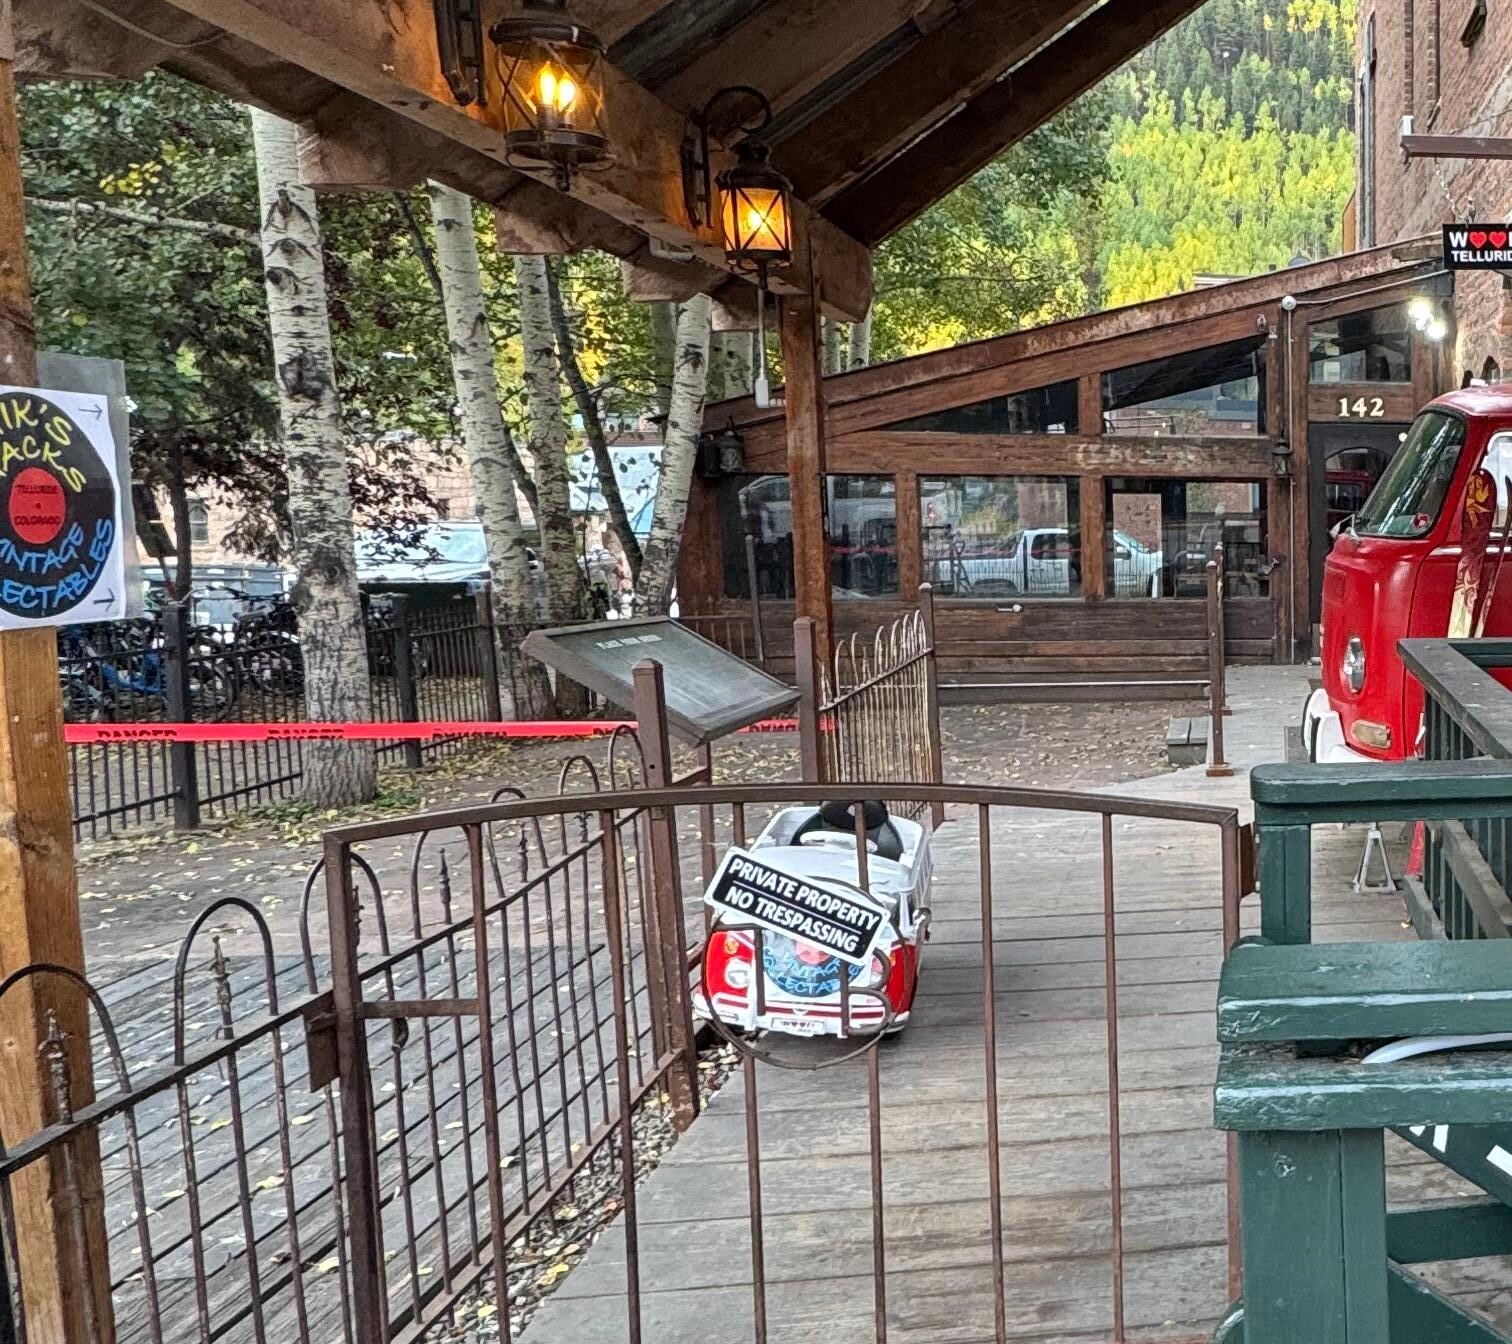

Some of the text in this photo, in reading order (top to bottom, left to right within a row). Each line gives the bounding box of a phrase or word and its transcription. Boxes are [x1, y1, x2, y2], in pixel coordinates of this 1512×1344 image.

[0, 398, 73, 447] IK'S
[1339, 397, 1385, 418] 142
[0, 435, 88, 494] ACKS
[0, 522, 84, 575] INTAGE
[0, 518, 113, 610] ECTABLES
[725, 886, 860, 953] NO TRESPASSING
[729, 858, 880, 931] PRIVATE PROPERTY
